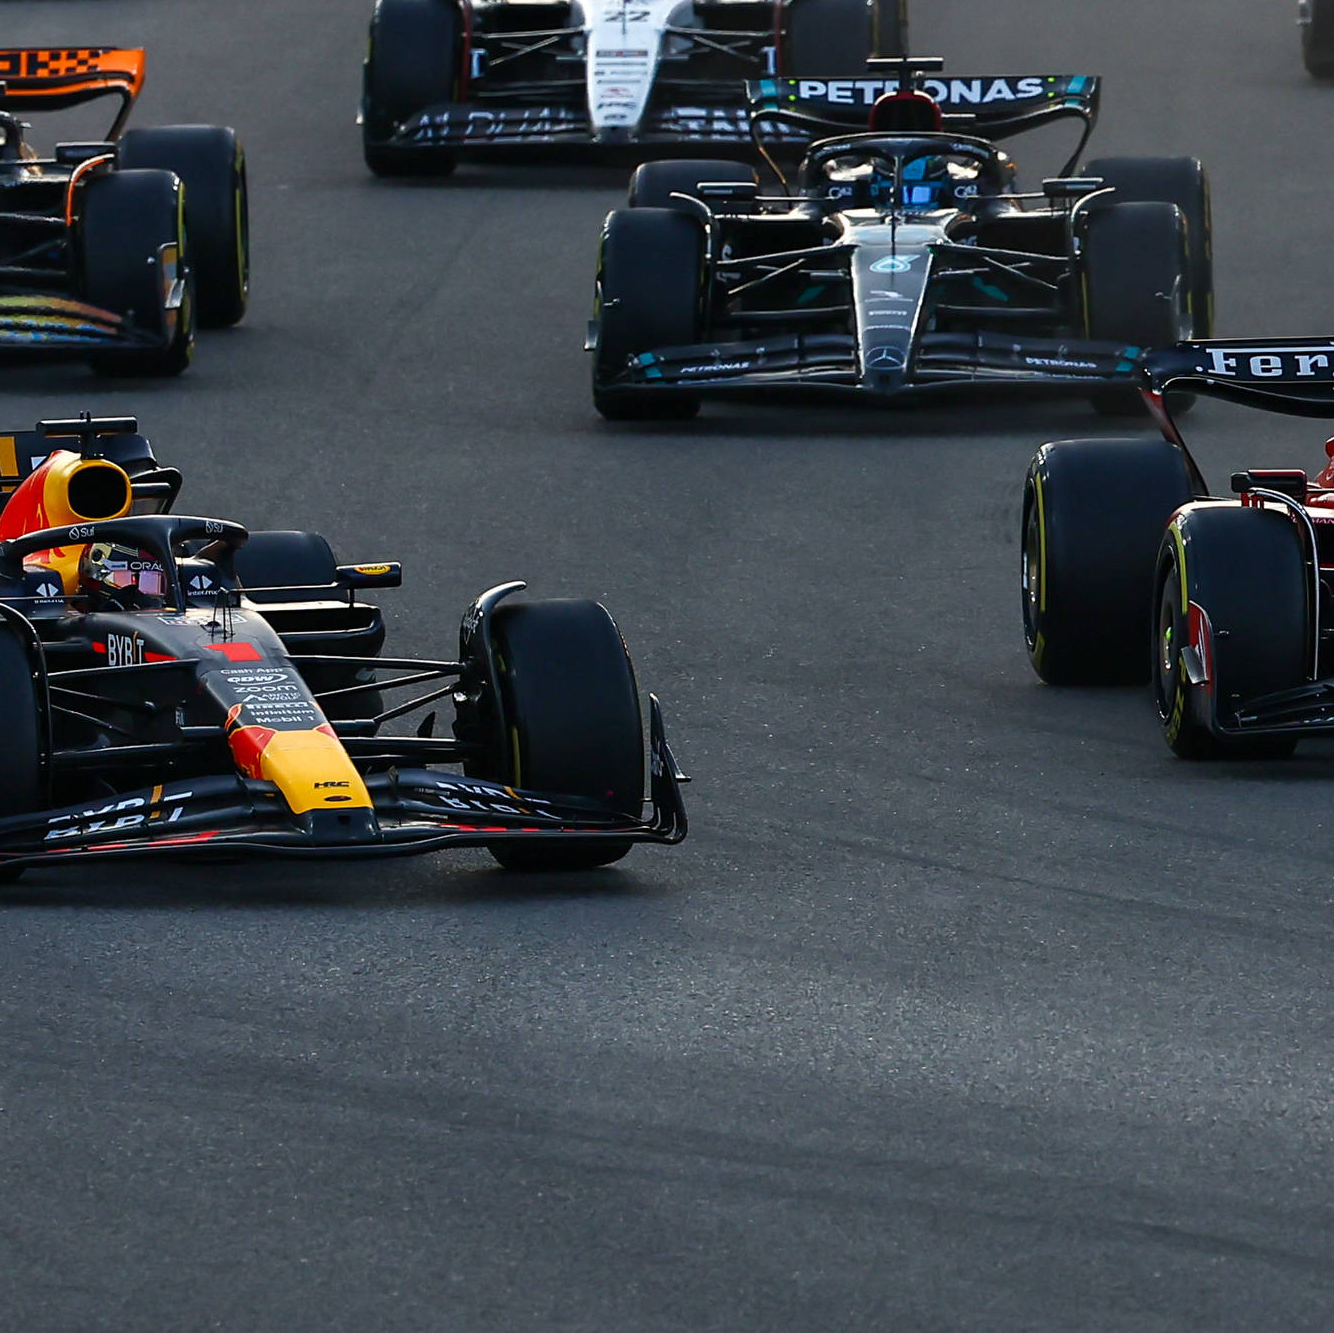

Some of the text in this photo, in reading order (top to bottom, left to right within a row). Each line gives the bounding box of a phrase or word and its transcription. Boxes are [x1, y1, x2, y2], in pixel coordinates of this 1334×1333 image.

[107, 631, 145, 666] BYBIT
[202, 641, 264, 662] 1
[234, 684, 298, 693] zoom
[256, 716, 302, 724] Mobil
[314, 781, 350, 789] HRC
